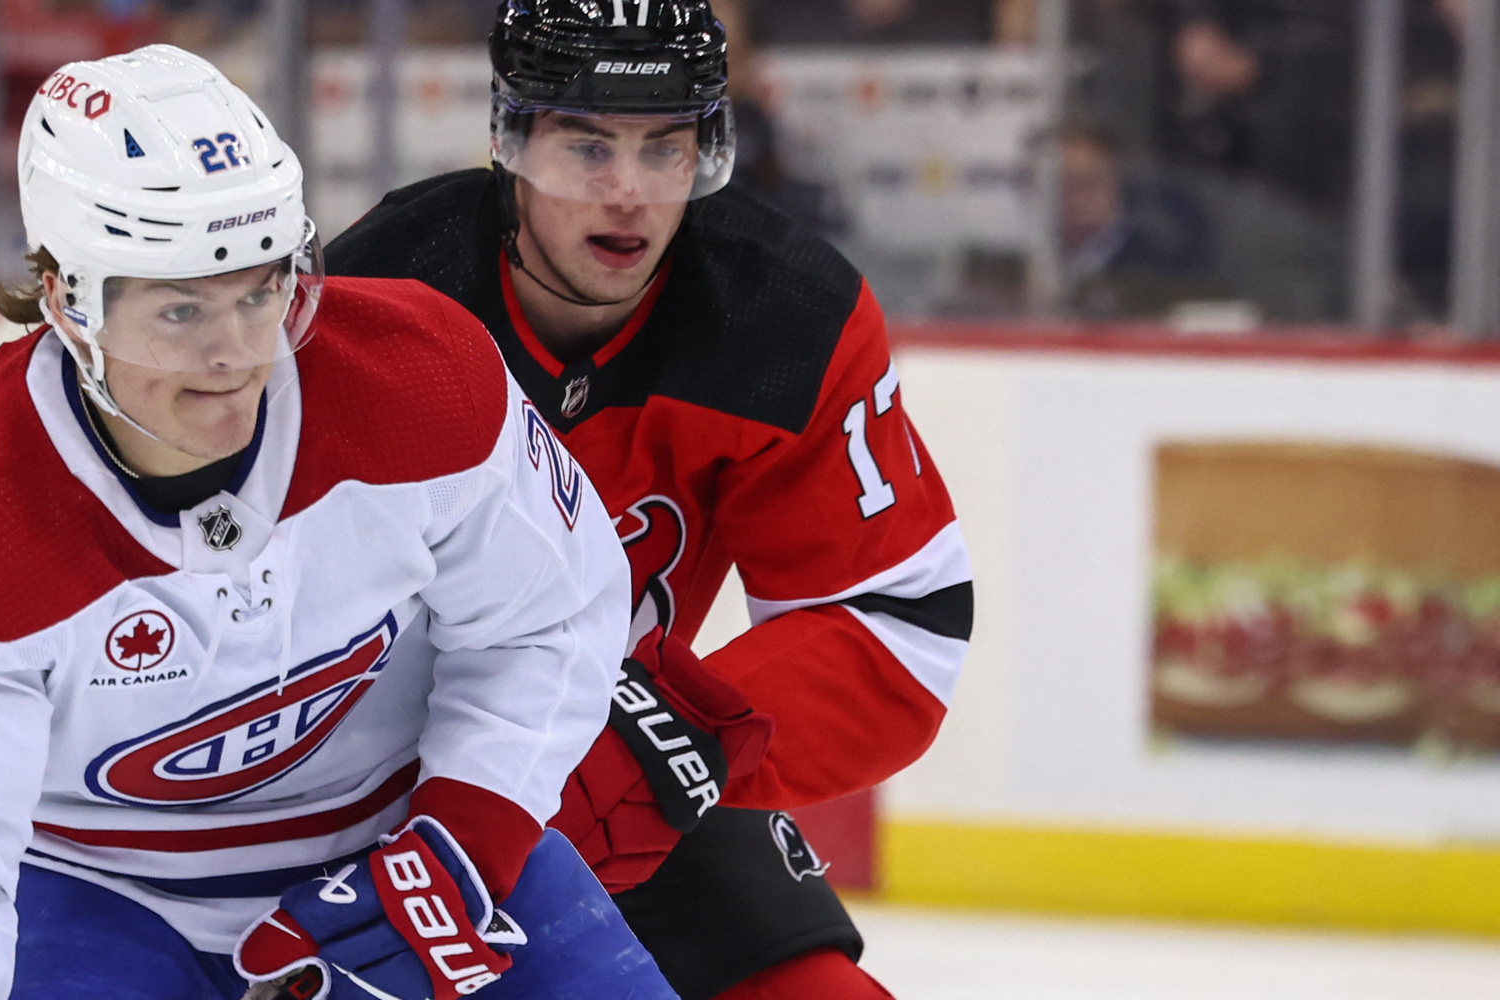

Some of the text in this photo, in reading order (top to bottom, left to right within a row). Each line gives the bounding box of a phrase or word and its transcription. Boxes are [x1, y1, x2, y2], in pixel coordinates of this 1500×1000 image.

[593, 61, 672, 75] BAUER
[38, 72, 90, 109] CIBC
[191, 131, 253, 176] 22
[206, 206, 278, 234] BAUER
[89, 668, 188, 687] AIR CANADA
